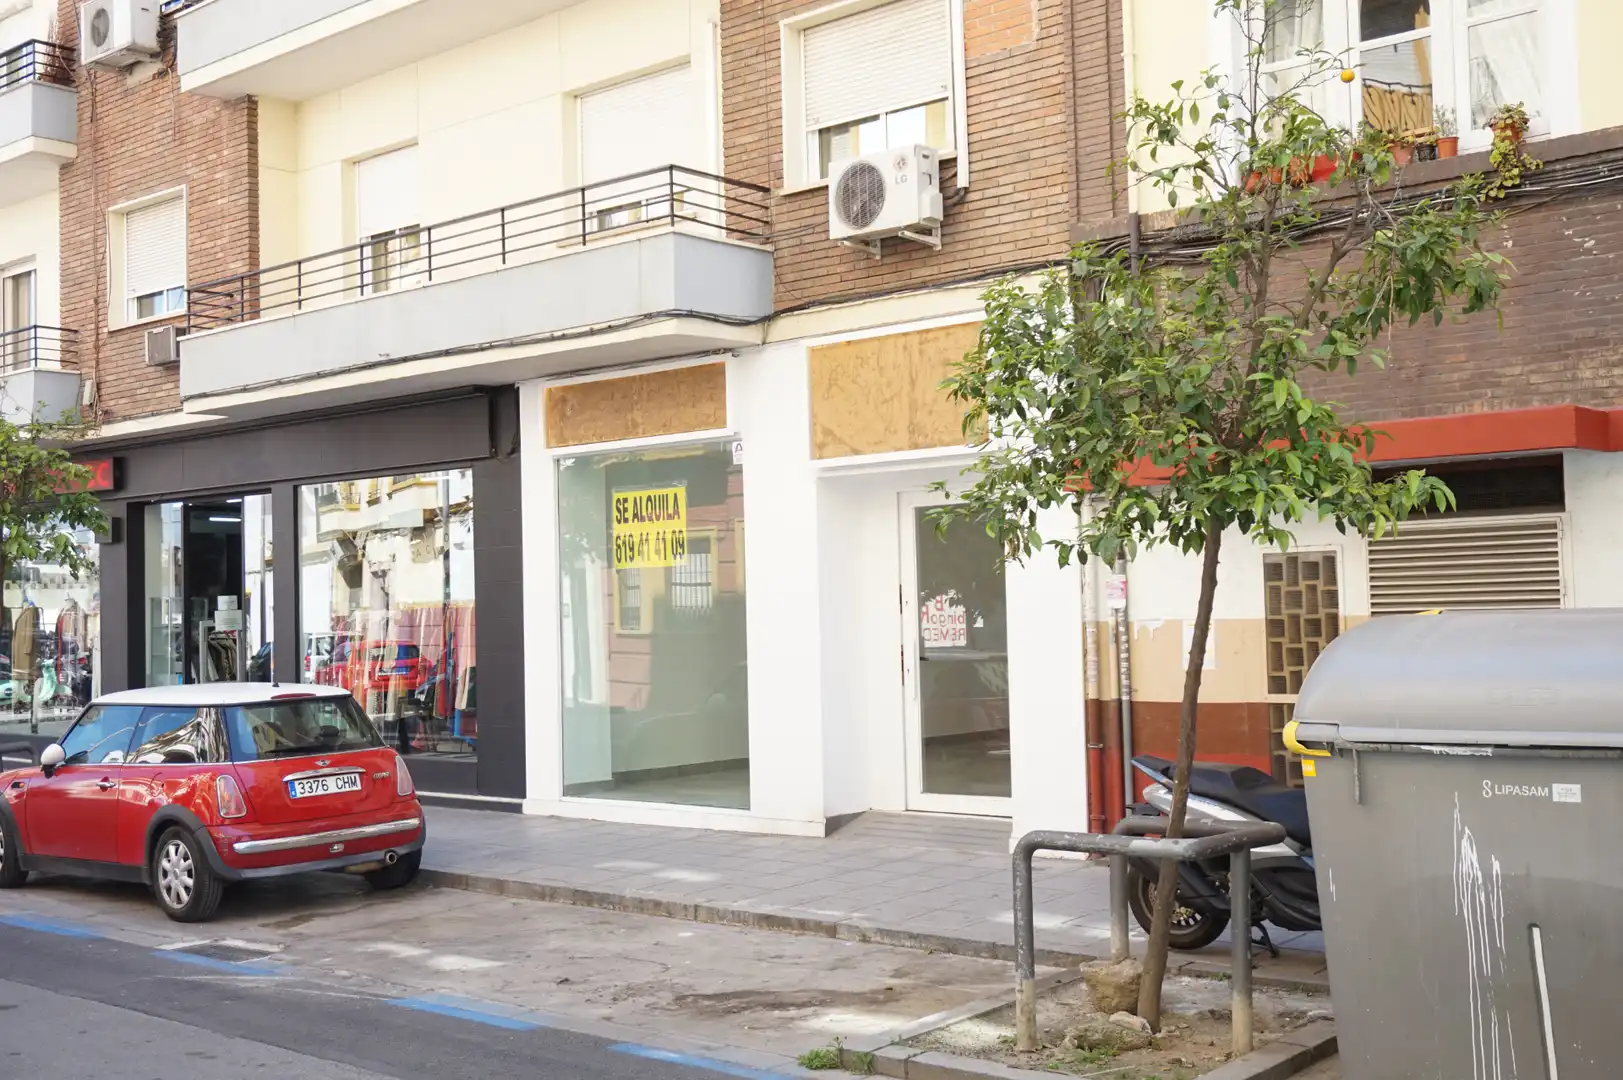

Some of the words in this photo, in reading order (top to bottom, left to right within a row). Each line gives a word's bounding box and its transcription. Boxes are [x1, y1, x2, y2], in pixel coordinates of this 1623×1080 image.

[895, 174, 908, 185] LG
[615, 497, 629, 525] SE
[632, 492, 680, 524] ALQUILA
[615, 532, 635, 563] 619
[638, 532, 650, 561] 41
[655, 530, 667, 560] 41
[671, 529, 685, 557] 09
[298, 779, 329, 795] 3376
[335, 775, 358, 790] CHM
[1494, 784, 1549, 797] LIPASAM
